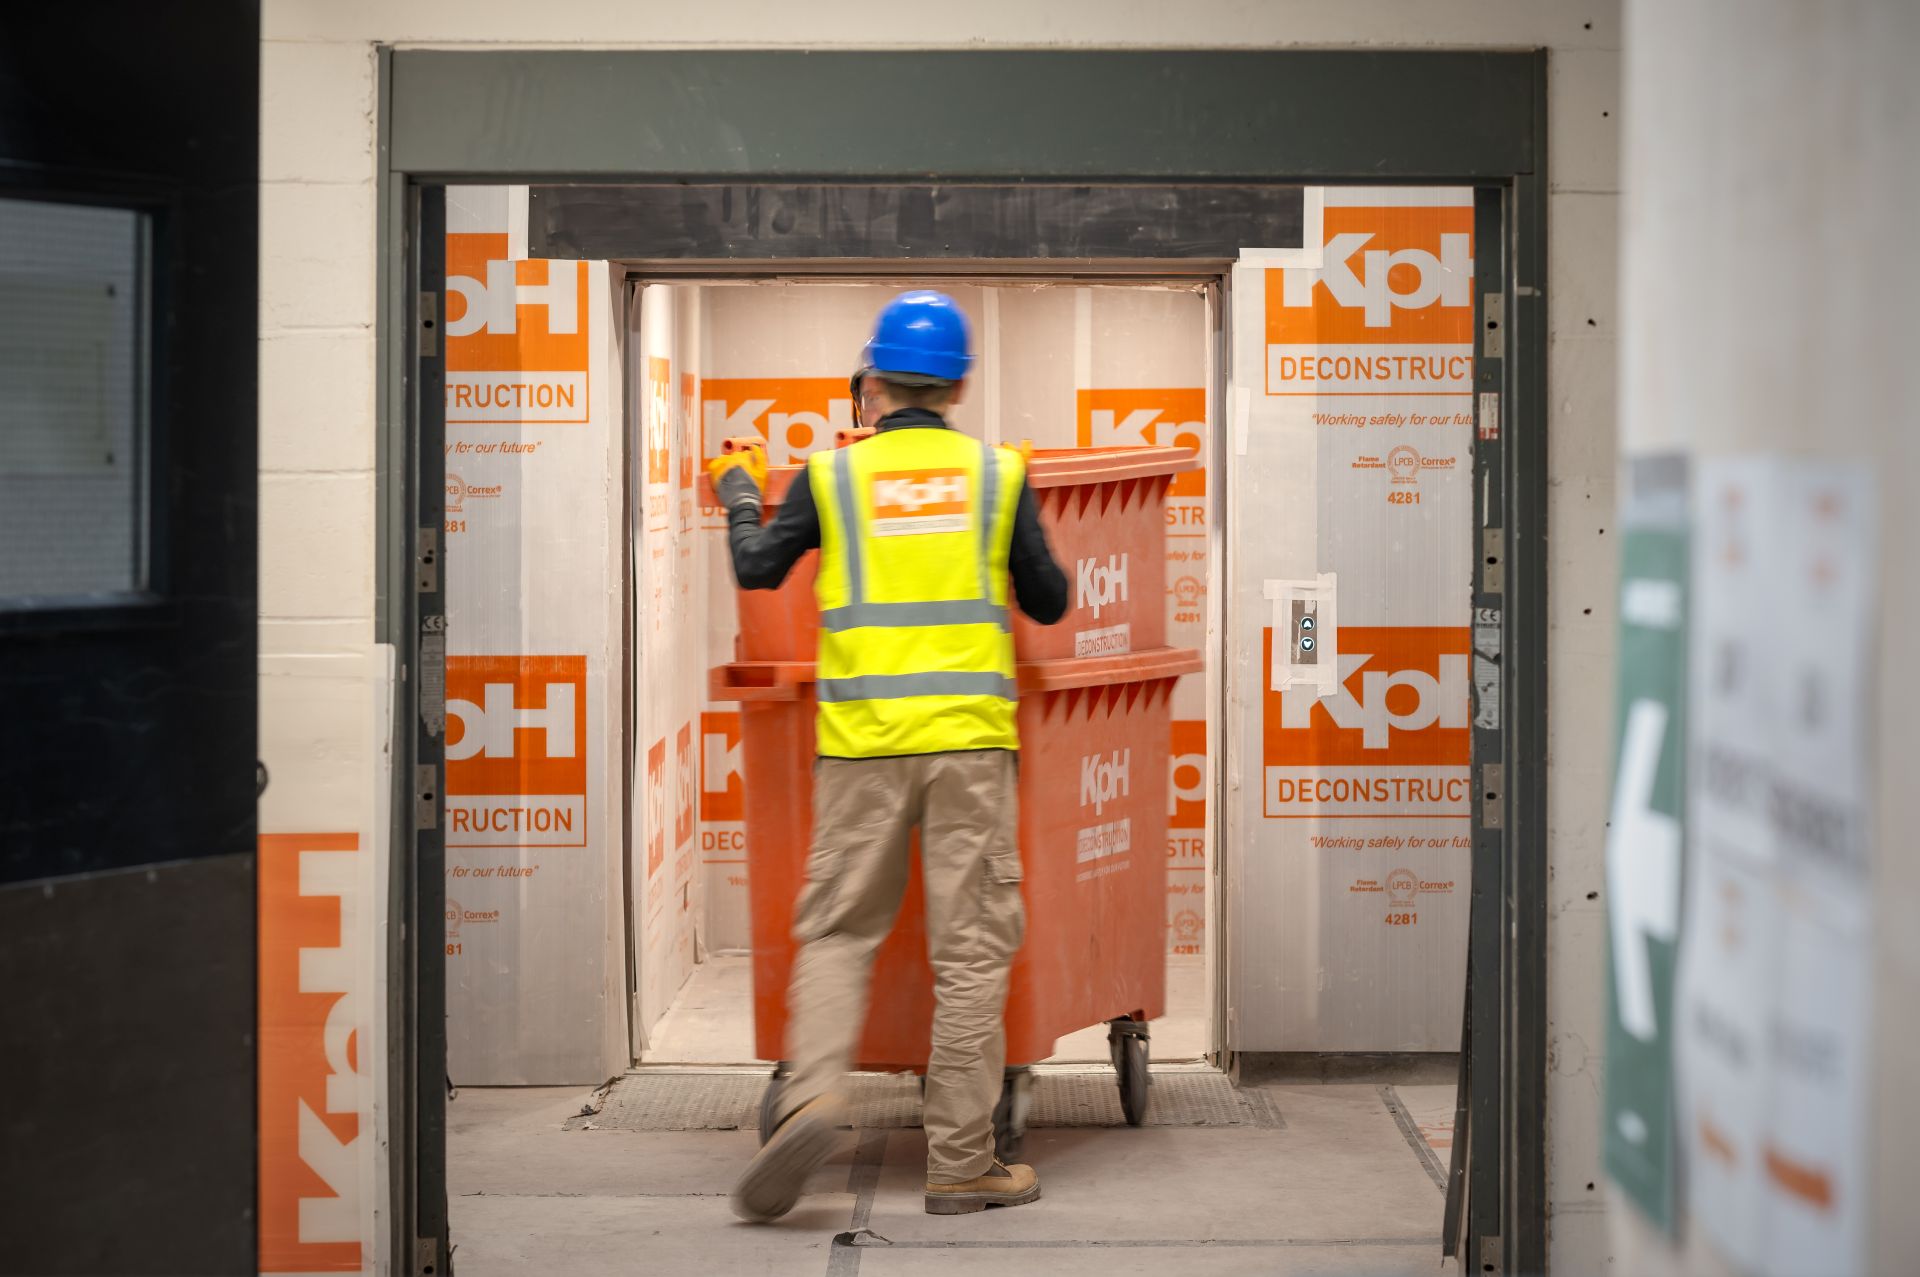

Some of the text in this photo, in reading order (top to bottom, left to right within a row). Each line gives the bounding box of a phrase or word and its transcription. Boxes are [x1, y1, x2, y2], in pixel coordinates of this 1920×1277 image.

[1369, 413, 1406, 428] safely
[1408, 413, 1429, 425] for
[1430, 416, 1451, 425] our
[455, 442, 474, 453] for
[475, 444, 497, 453] our
[1394, 457, 1414, 466] LPCB
[1387, 491, 1420, 504] 4281
[1077, 553, 1128, 619] KpH
[1080, 749, 1130, 816] KpH
[1367, 836, 1405, 851] safely
[1406, 836, 1426, 848] for
[1427, 839, 1449, 848] our
[452, 865, 471, 878] for
[472, 868, 494, 878] our
[1392, 880, 1412, 890] LPCB
[1385, 912, 1418, 926] 4281
